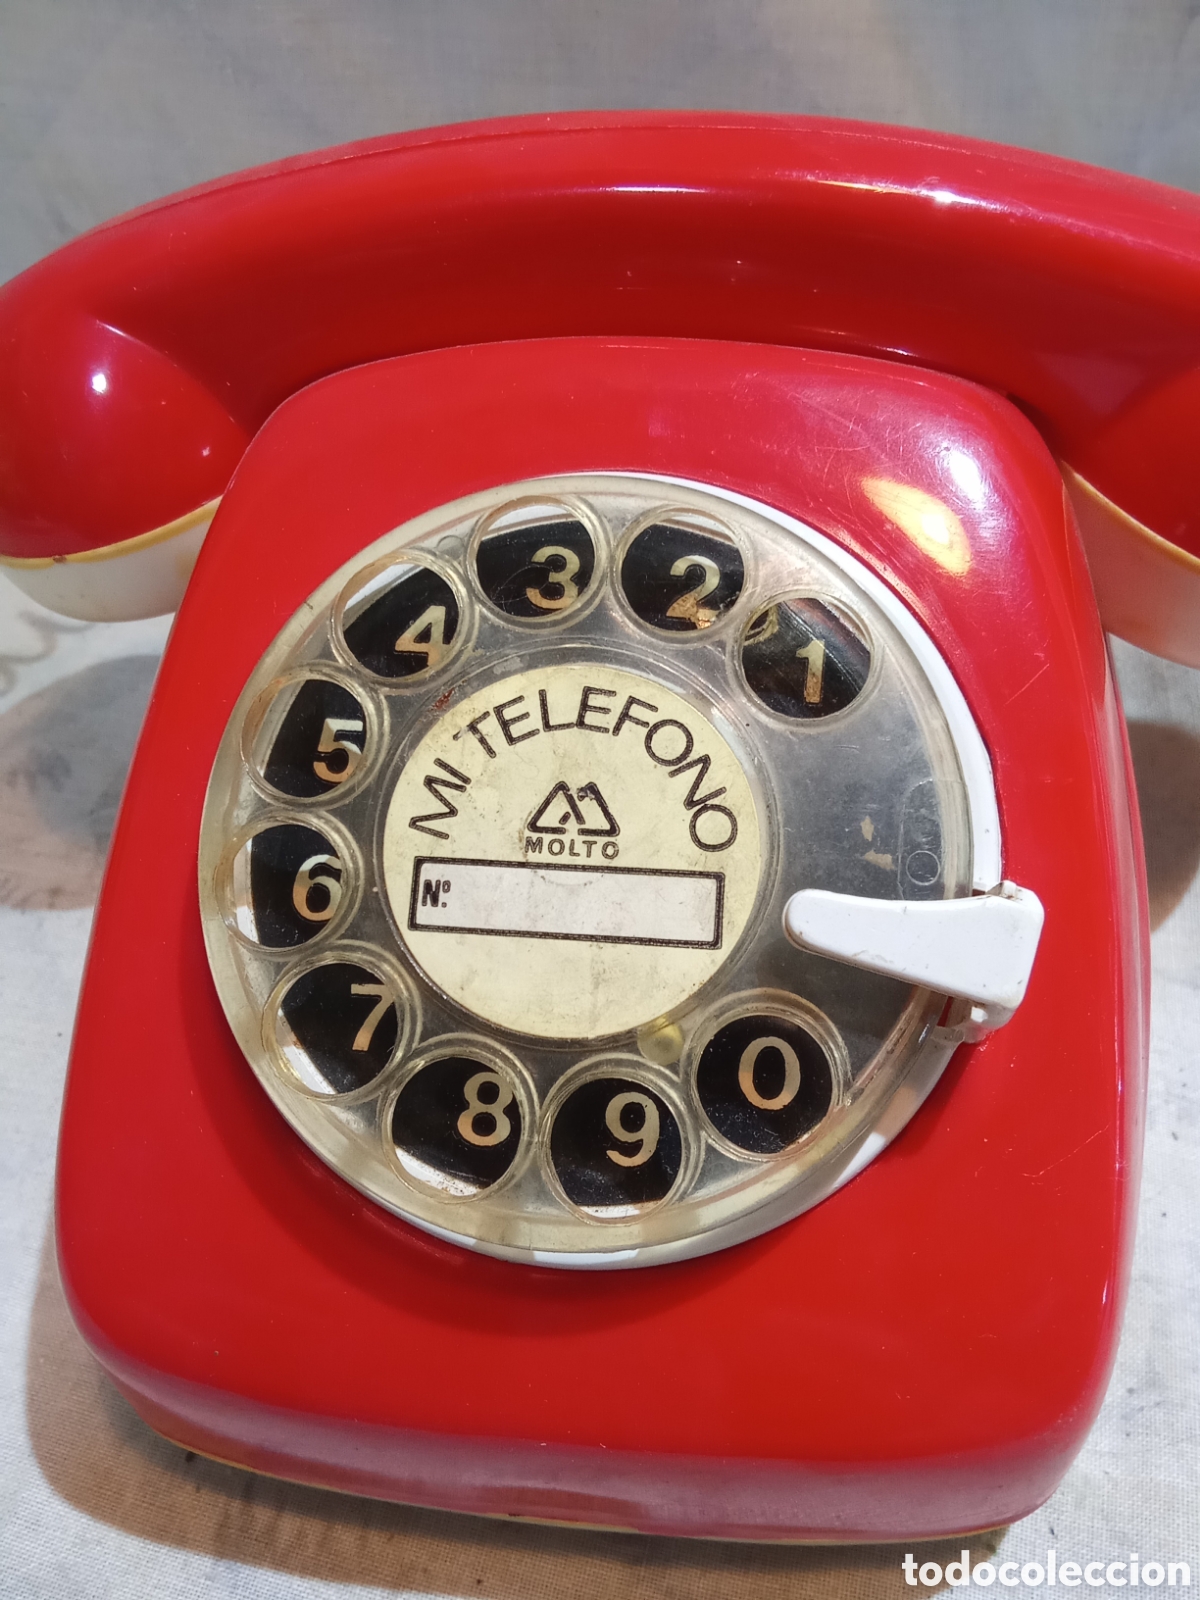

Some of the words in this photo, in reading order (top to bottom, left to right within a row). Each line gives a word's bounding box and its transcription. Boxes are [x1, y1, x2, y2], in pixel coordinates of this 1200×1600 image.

[526, 545, 581, 609] 3
[666, 554, 721, 629] 2
[394, 605, 451, 668] 4
[795, 640, 825, 704] 1
[312, 718, 364, 783] 5
[409, 758, 471, 840] MI
[453, 686, 738, 852] TELEFONO
[525, 836, 620, 859] MOLTO
[292, 854, 343, 922] 6
[350, 982, 396, 1052] 7
[738, 1036, 801, 1110] 0
[456, 1072, 512, 1147] 8
[606, 1092, 660, 1168] 9
